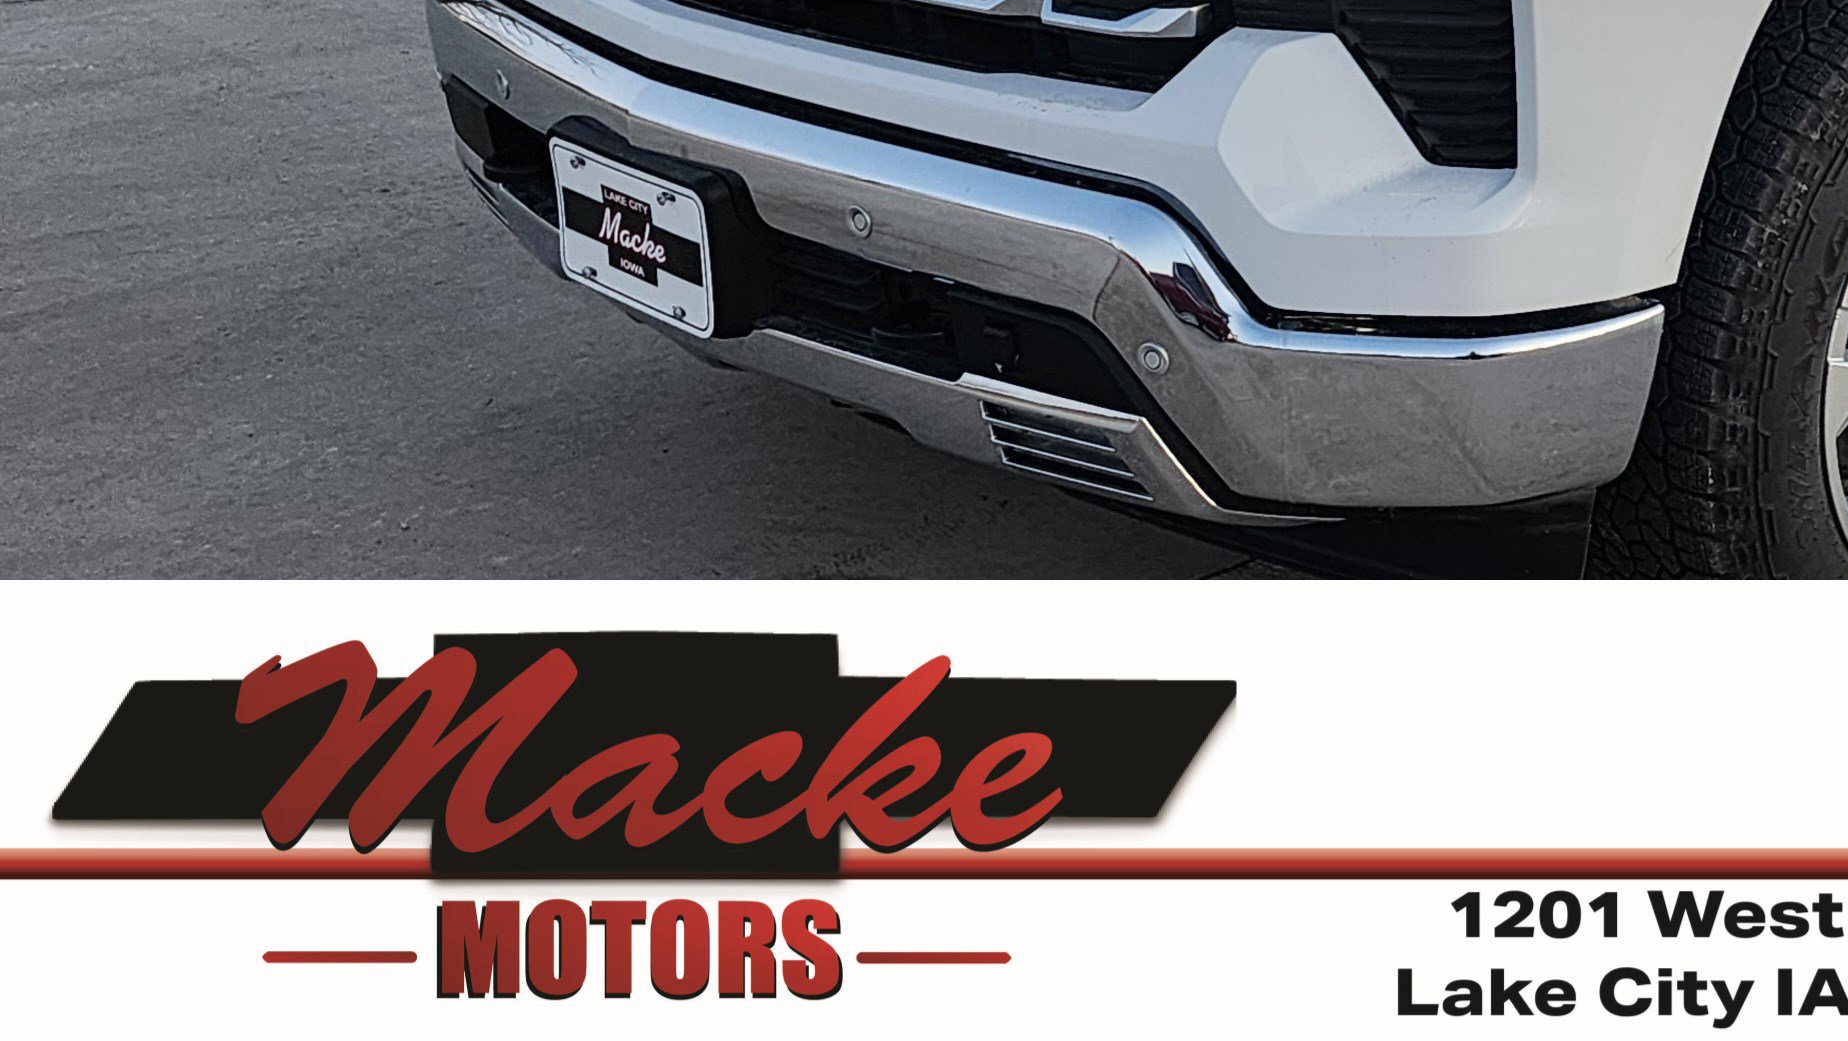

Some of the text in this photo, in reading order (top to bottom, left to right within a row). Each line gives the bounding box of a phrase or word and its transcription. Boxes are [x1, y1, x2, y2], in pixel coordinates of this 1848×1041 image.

[603, 188, 649, 216] LAKE CITY
[598, 206, 667, 264] Macke
[620, 257, 646, 278] IOWA
